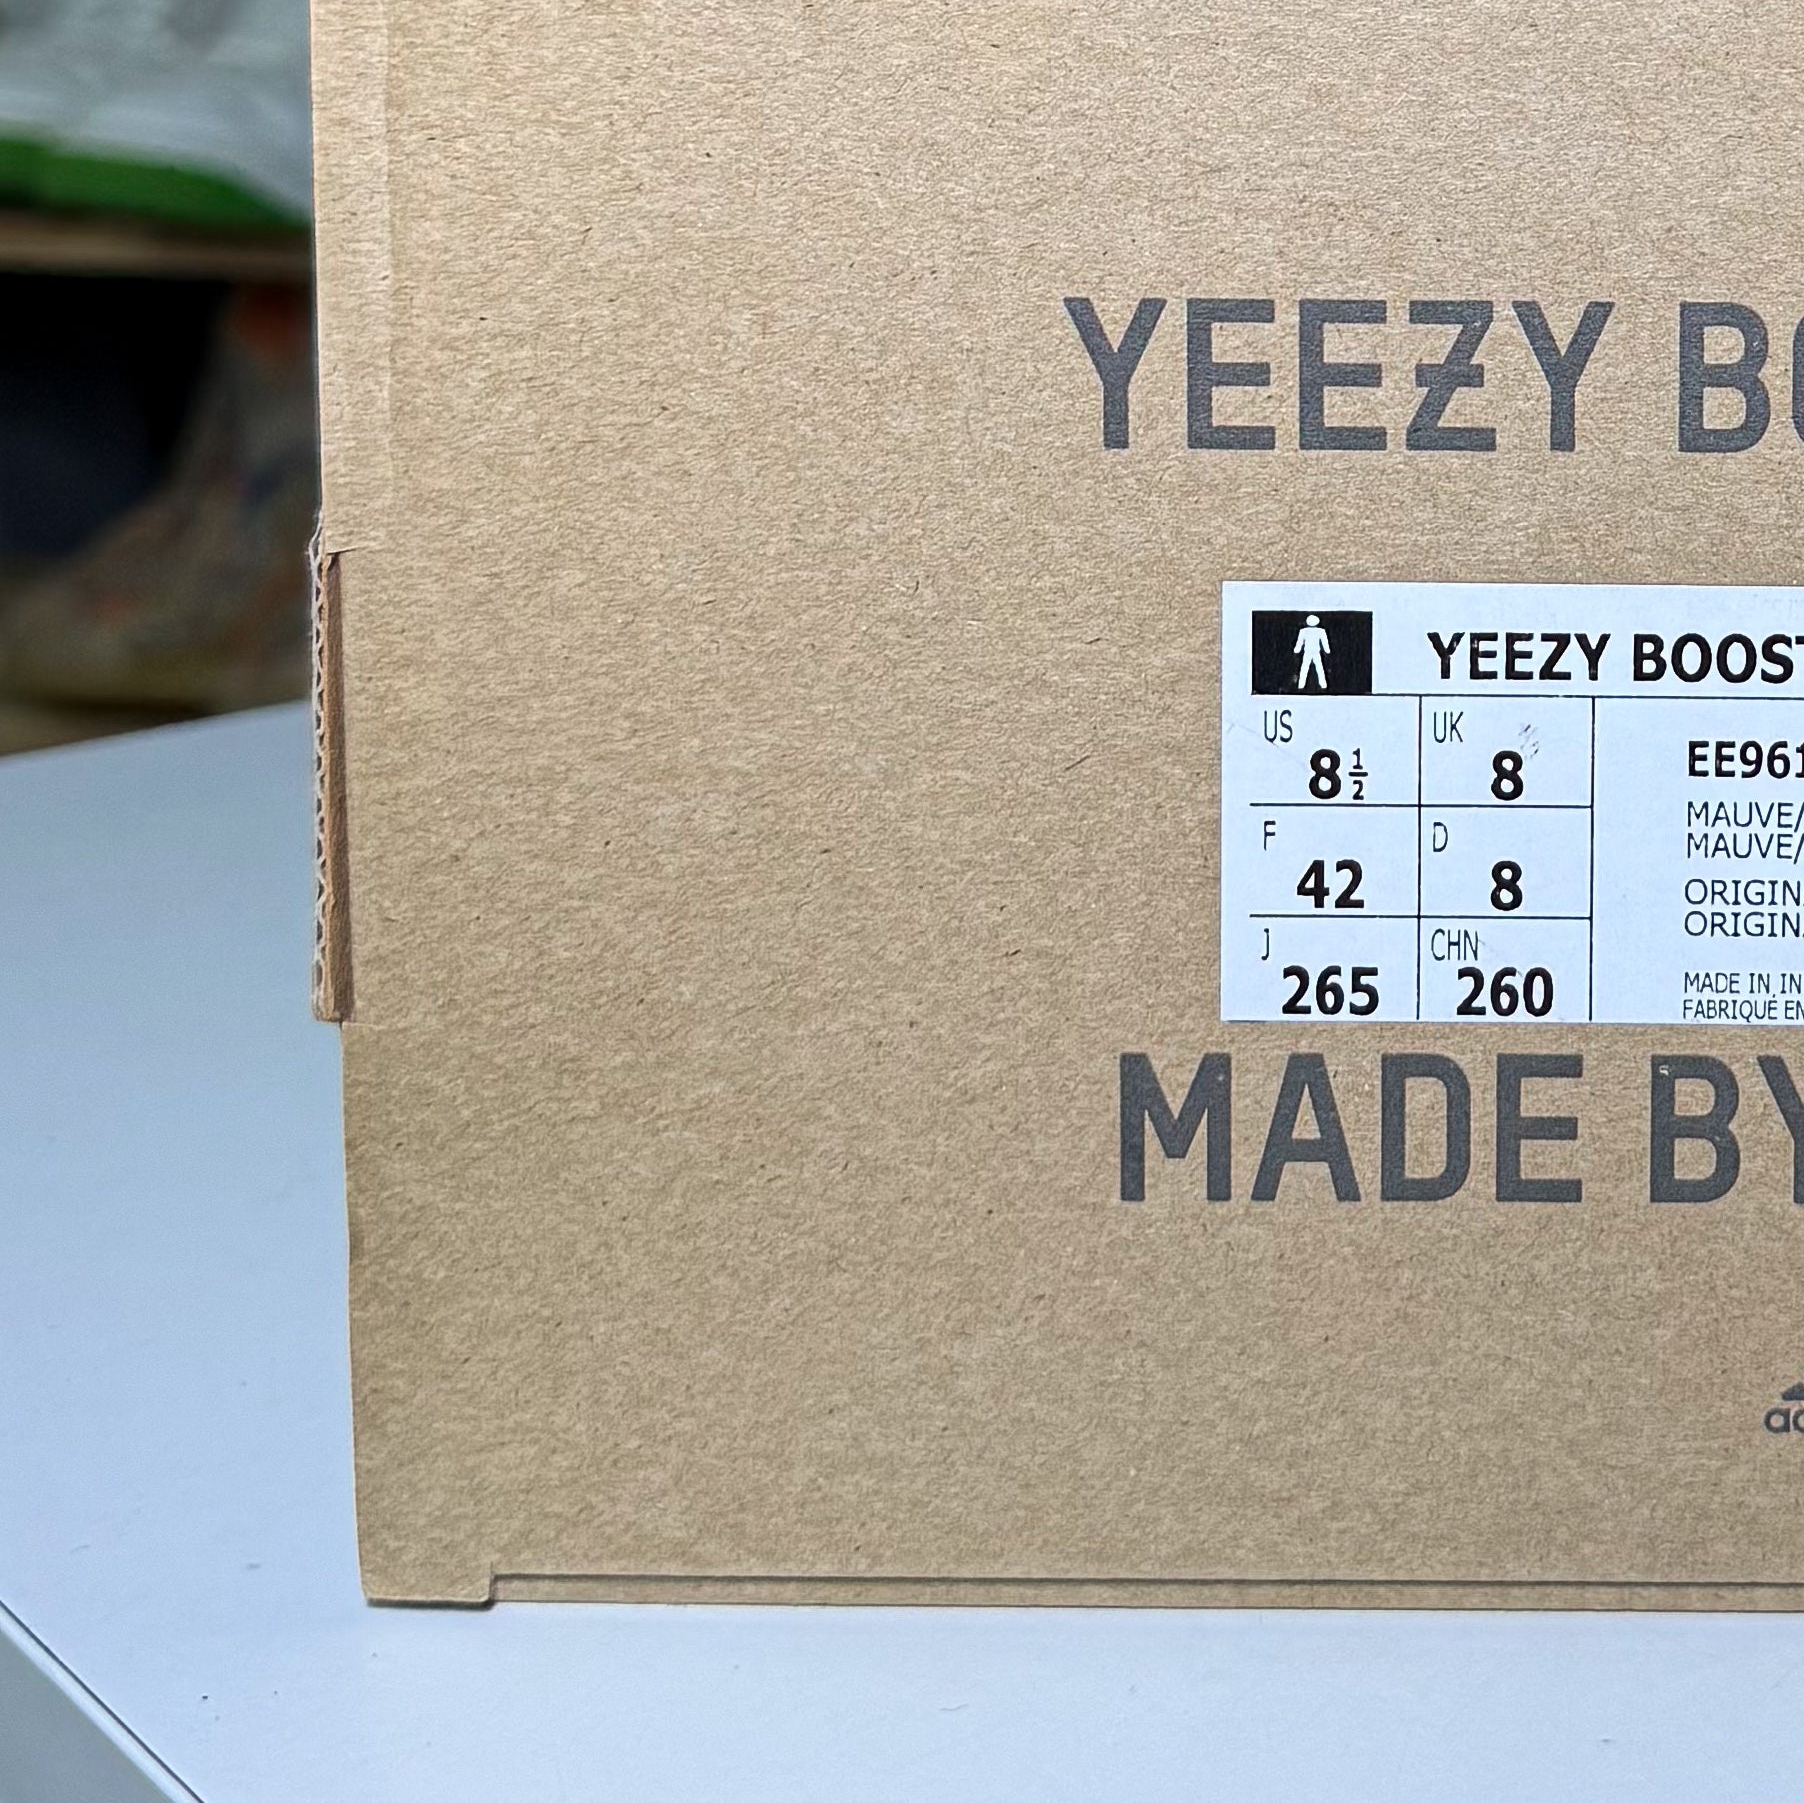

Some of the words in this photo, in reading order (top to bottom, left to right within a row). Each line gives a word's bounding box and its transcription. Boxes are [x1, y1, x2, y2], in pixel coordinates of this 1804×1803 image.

[1063, 297, 1614, 453] YEEZY
[1427, 632, 1611, 682] YEEZY
[1263, 709, 1293, 744] US
[1433, 711, 1464, 744] UK
[1490, 750, 1524, 802] 8
[1263, 820, 1277, 851] F
[1432, 821, 1449, 853] D
[1296, 859, 1365, 909] 42
[1490, 860, 1523, 912] 8
[1260, 927, 1270, 961] J
[1430, 928, 1479, 962] CHN
[1281, 965, 1380, 1017] 265
[1456, 966, 1554, 1018] 260
[1684, 971, 1741, 994] MADE
[1748, 972, 1771, 995] IN
[1120, 1052, 1584, 1203] MADE
